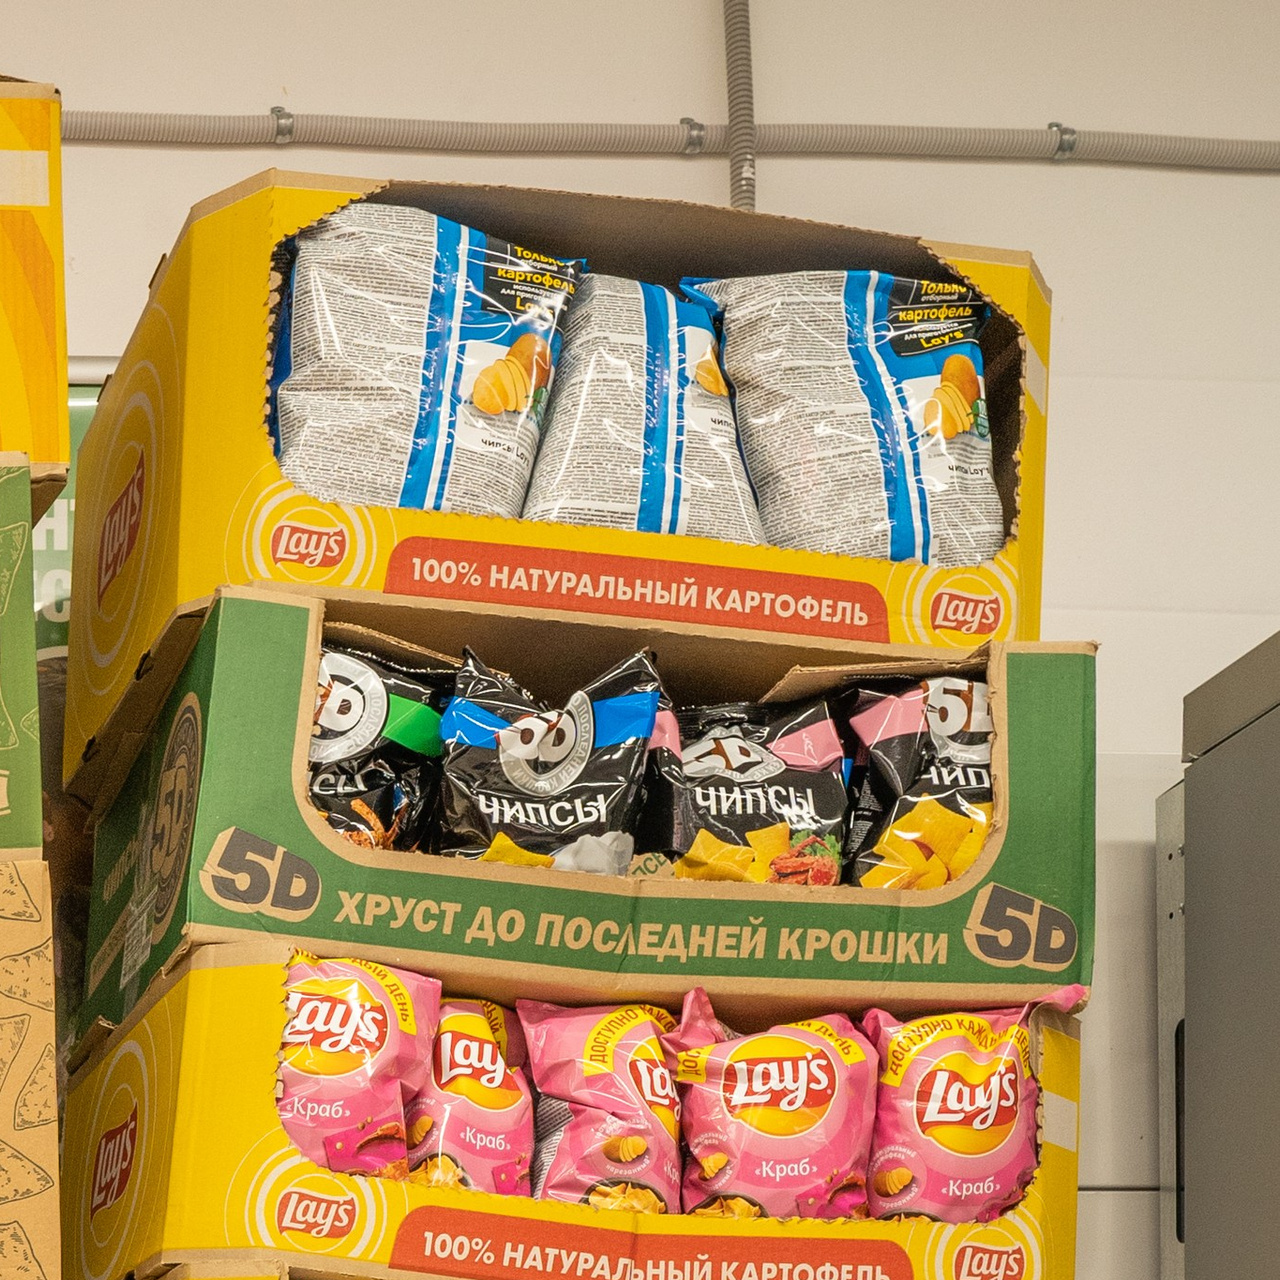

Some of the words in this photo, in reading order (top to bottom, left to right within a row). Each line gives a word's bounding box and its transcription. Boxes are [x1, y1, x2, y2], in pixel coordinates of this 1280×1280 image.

[899, 305, 972, 321] картофель
[274, 523, 345, 568] Lay's
[412, 557, 482, 587] 100%
[488, 565, 699, 606] НАТУРАЛЬНЫЙ
[705, 587, 869, 627] КАРТОФЕЛЬ
[933, 592, 1002, 634] Lay's
[479, 794, 608, 826] ЧИПСЫ
[695, 785, 816, 818] ЧИПСЫ
[211, 828, 320, 911] 5D
[333, 891, 461, 933] ХРУСТ
[469, 903, 526, 945] ДО
[534, 913, 767, 963] ПОСЛЕДНЕЙ
[777, 928, 950, 966] КРОШКИ
[972, 891, 1073, 968] 5D
[459, 1128, 512, 1151] «Краб»
[754, 1159, 818, 1181] «Краб»
[940, 1178, 1001, 1200] «Краб»
[279, 1193, 354, 1238] Lay's
[423, 1231, 495, 1264] 100%
